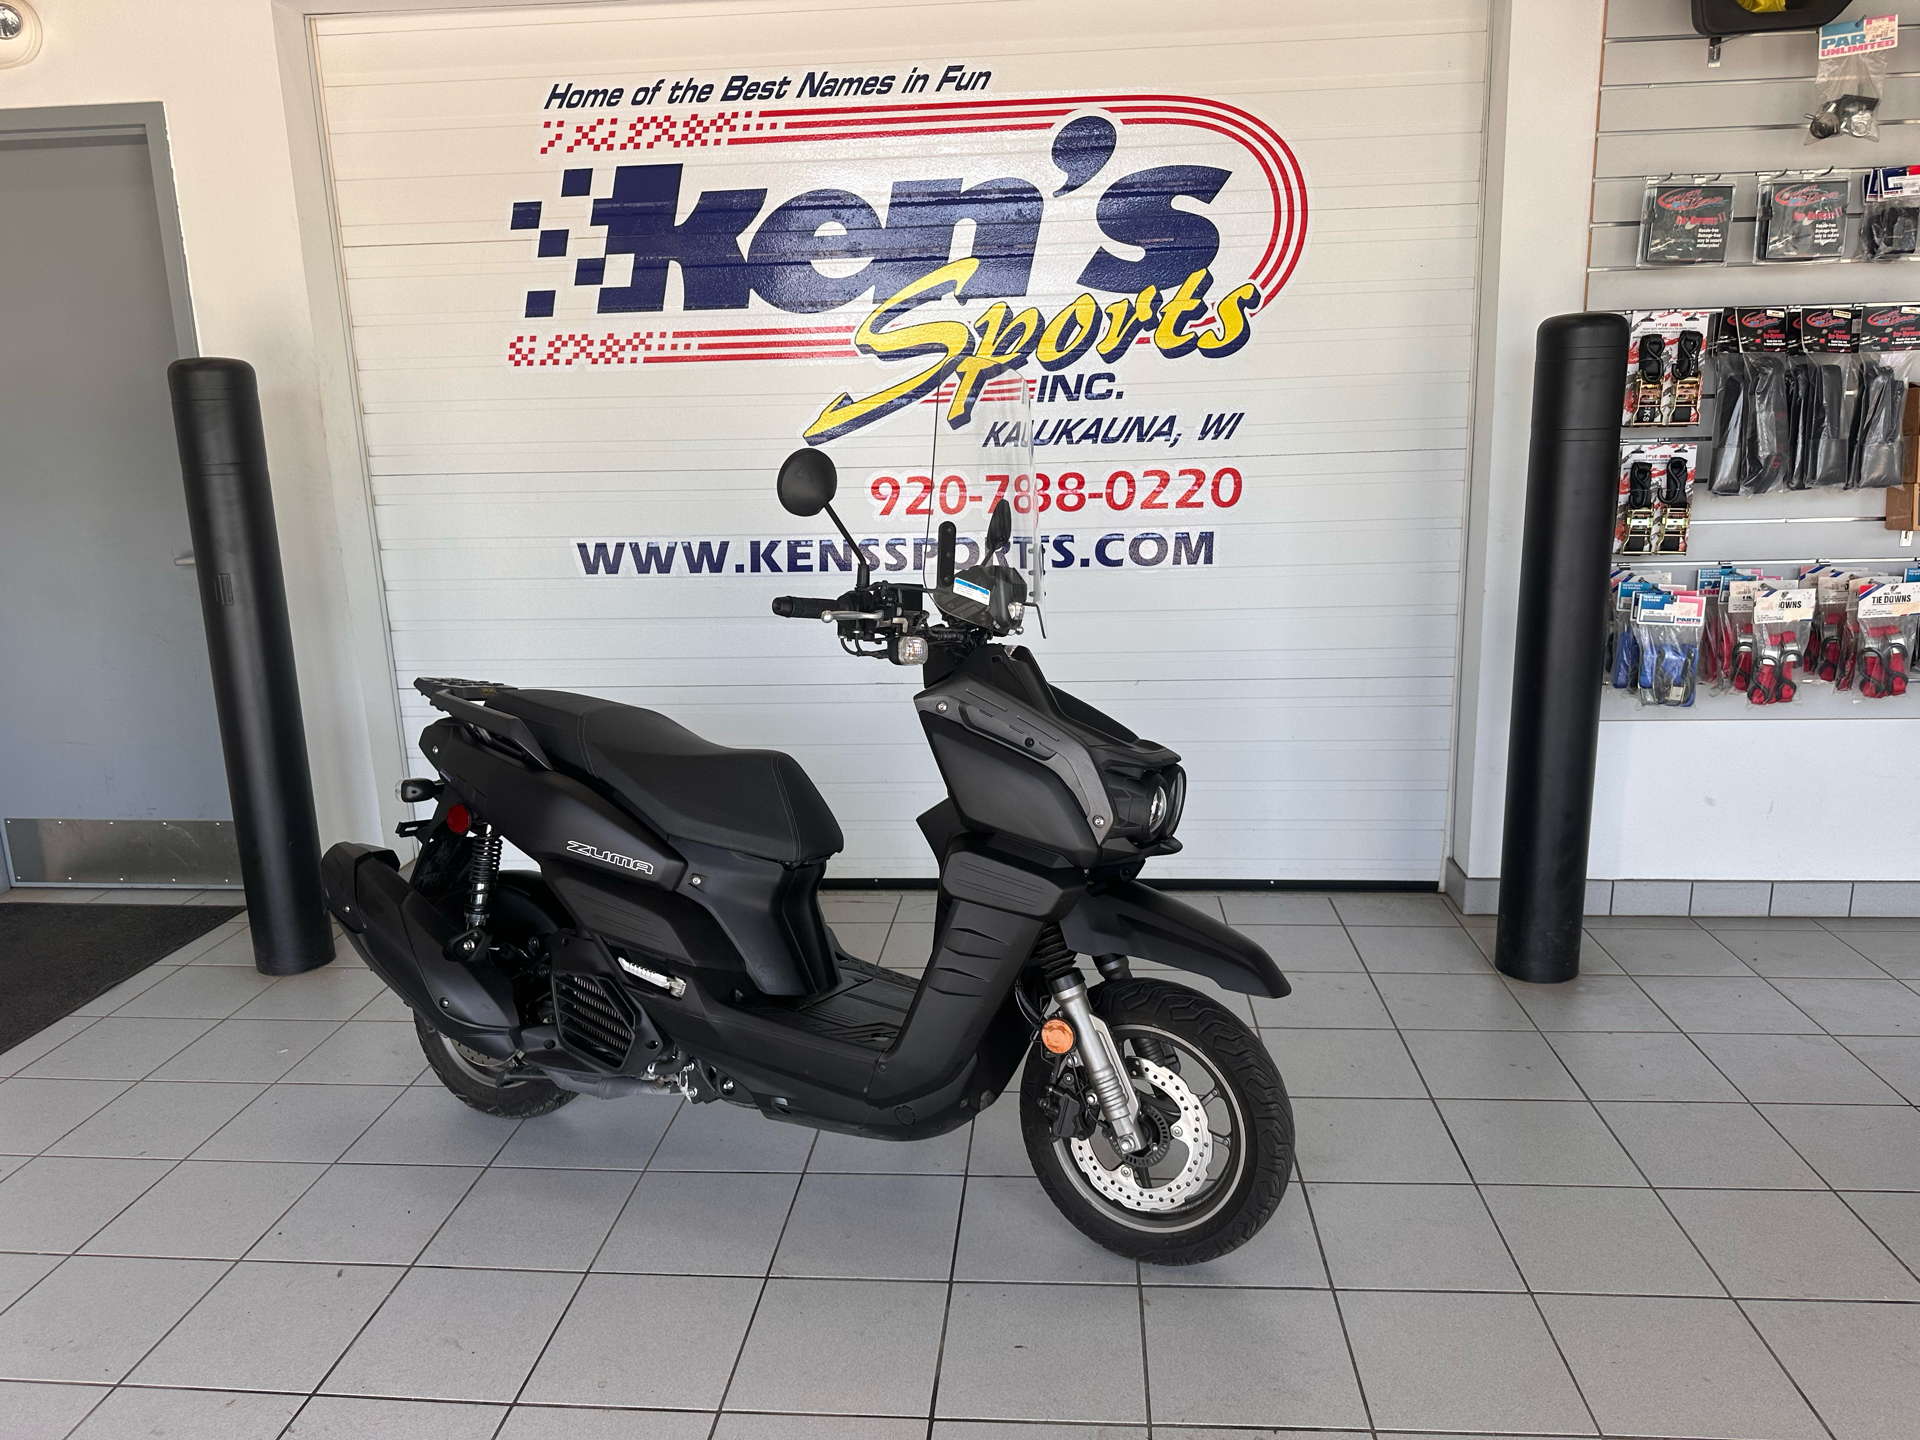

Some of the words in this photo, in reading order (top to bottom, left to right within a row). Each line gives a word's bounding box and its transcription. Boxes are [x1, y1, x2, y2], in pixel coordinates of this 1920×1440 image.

[1821, 39, 1895, 57] UNLIMITED
[544, 83, 625, 109] Home
[631, 79, 666, 106] of
[667, 78, 714, 104] the
[720, 75, 791, 102] Best
[796, 71, 896, 98] Names
[901, 67, 929, 93] in
[935, 65, 992, 92] Fun
[803, 257, 1262, 446] Sports
[1036, 372, 1124, 403] INC.
[1197, 412, 1245, 441] WI
[576, 531, 1215, 575] WWW.KENSSPORTS.COM
[1872, 595, 1882, 604] TIE
[1884, 595, 1911, 604] DOWNS
[566, 840, 654, 875] ZUMA
